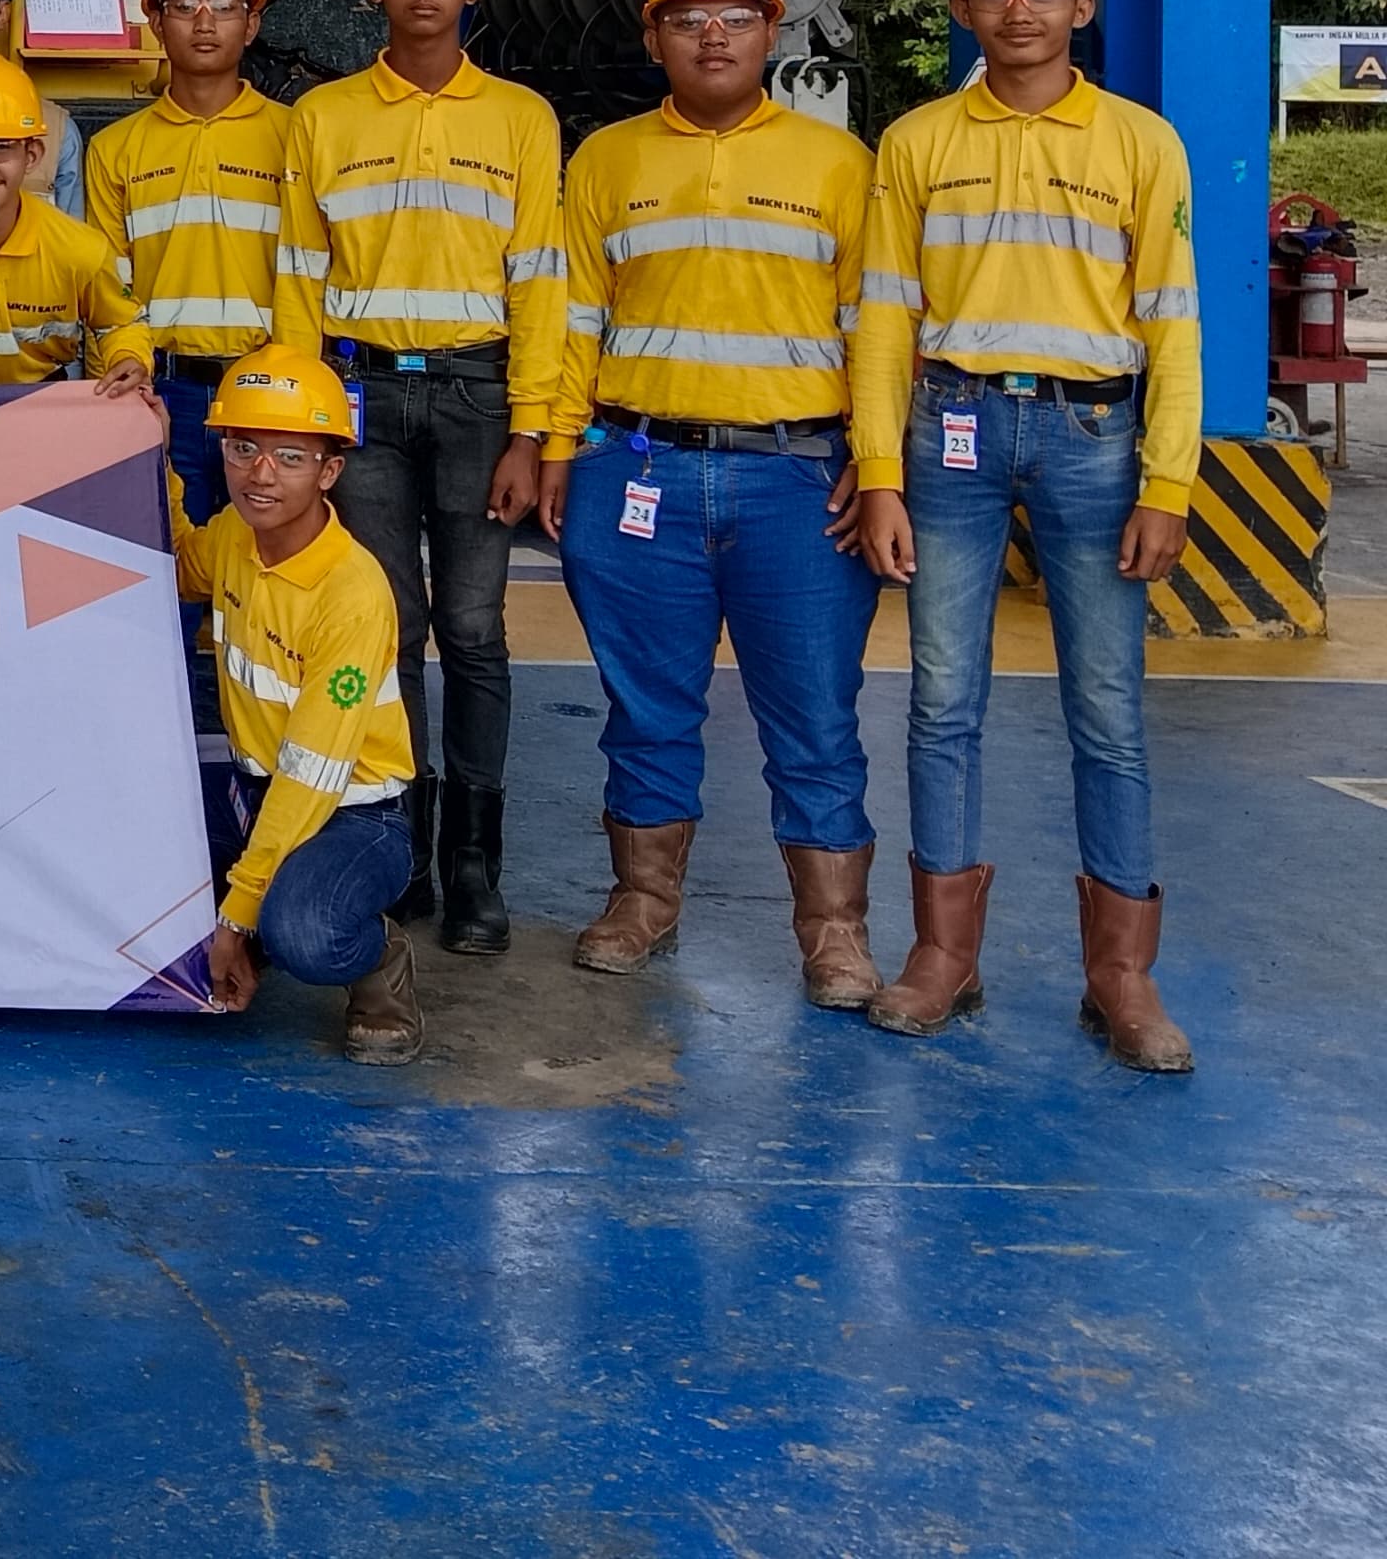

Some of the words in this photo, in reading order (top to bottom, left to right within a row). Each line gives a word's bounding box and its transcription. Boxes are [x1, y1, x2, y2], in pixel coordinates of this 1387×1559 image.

[629, 198, 659, 211] BAYU
[951, 438, 970, 453] 23
[630, 505, 650, 523] 24
